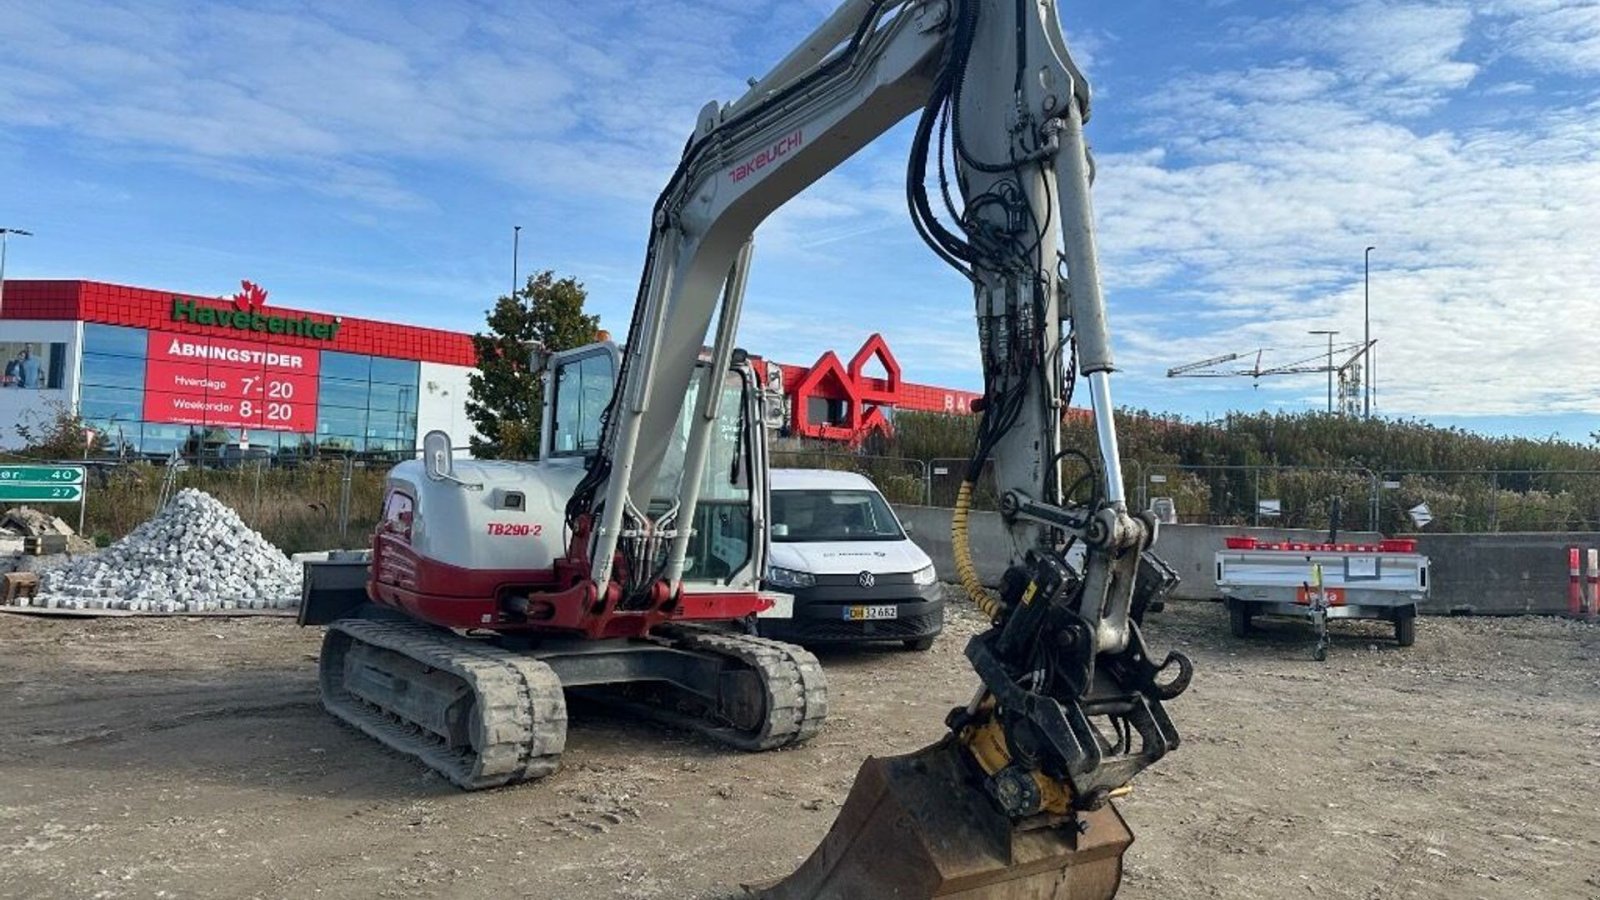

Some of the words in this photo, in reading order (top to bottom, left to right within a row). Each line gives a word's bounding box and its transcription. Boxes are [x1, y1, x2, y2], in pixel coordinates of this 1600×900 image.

[172, 297, 340, 340] Havecenter
[168, 339, 303, 369] ÅBNINGSTIDER
[268, 381, 294, 399] 20
[173, 399, 234, 413] Weekender
[239, 400, 252, 417] 8
[267, 404, 292, 421] 20
[944, 394, 973, 415] BA
[0, 470, 20, 479] ør
[51, 470, 72, 479] 40
[52, 487, 70, 497] 27
[487, 523, 542, 537] TB290-2
[865, 607, 876, 618] 32
[878, 607, 895, 617] 682
